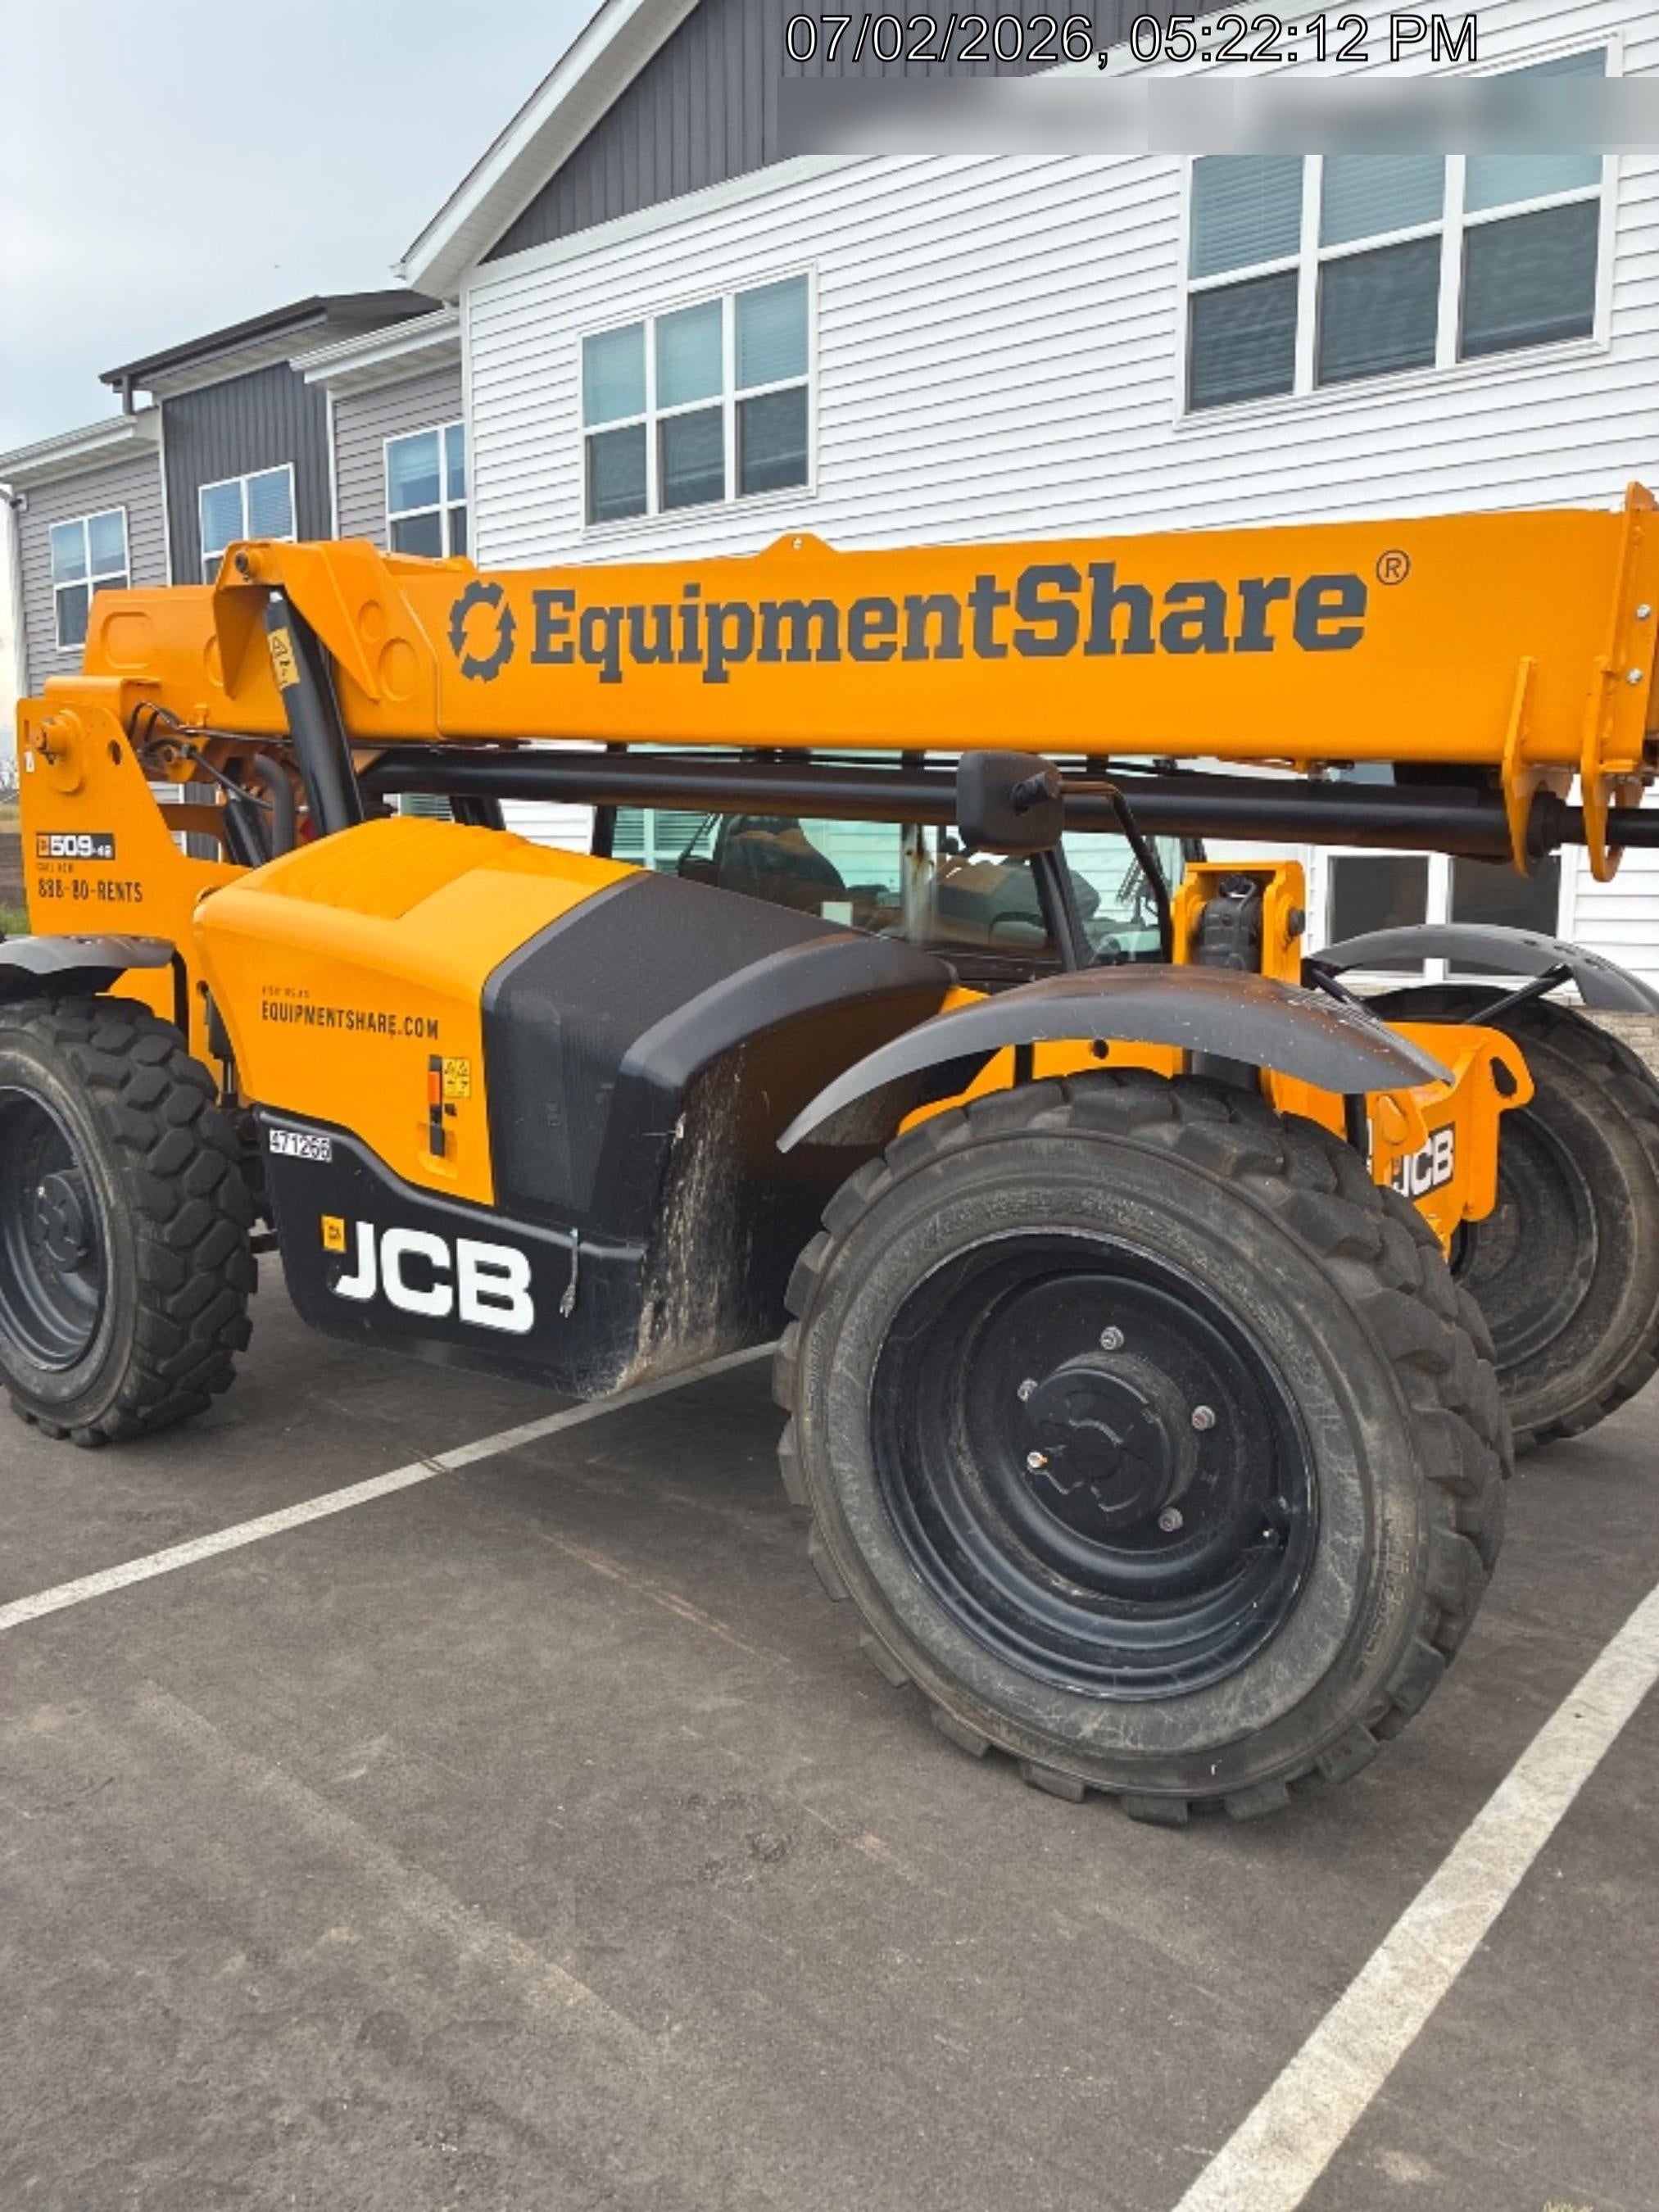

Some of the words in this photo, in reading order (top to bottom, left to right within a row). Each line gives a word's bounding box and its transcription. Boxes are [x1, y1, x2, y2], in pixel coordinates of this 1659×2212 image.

[261, 1000, 439, 1040] EQUIPMENTSHARE.COM
[1391, 1129, 1454, 1198] JCB
[334, 1220, 535, 1334] JCB
